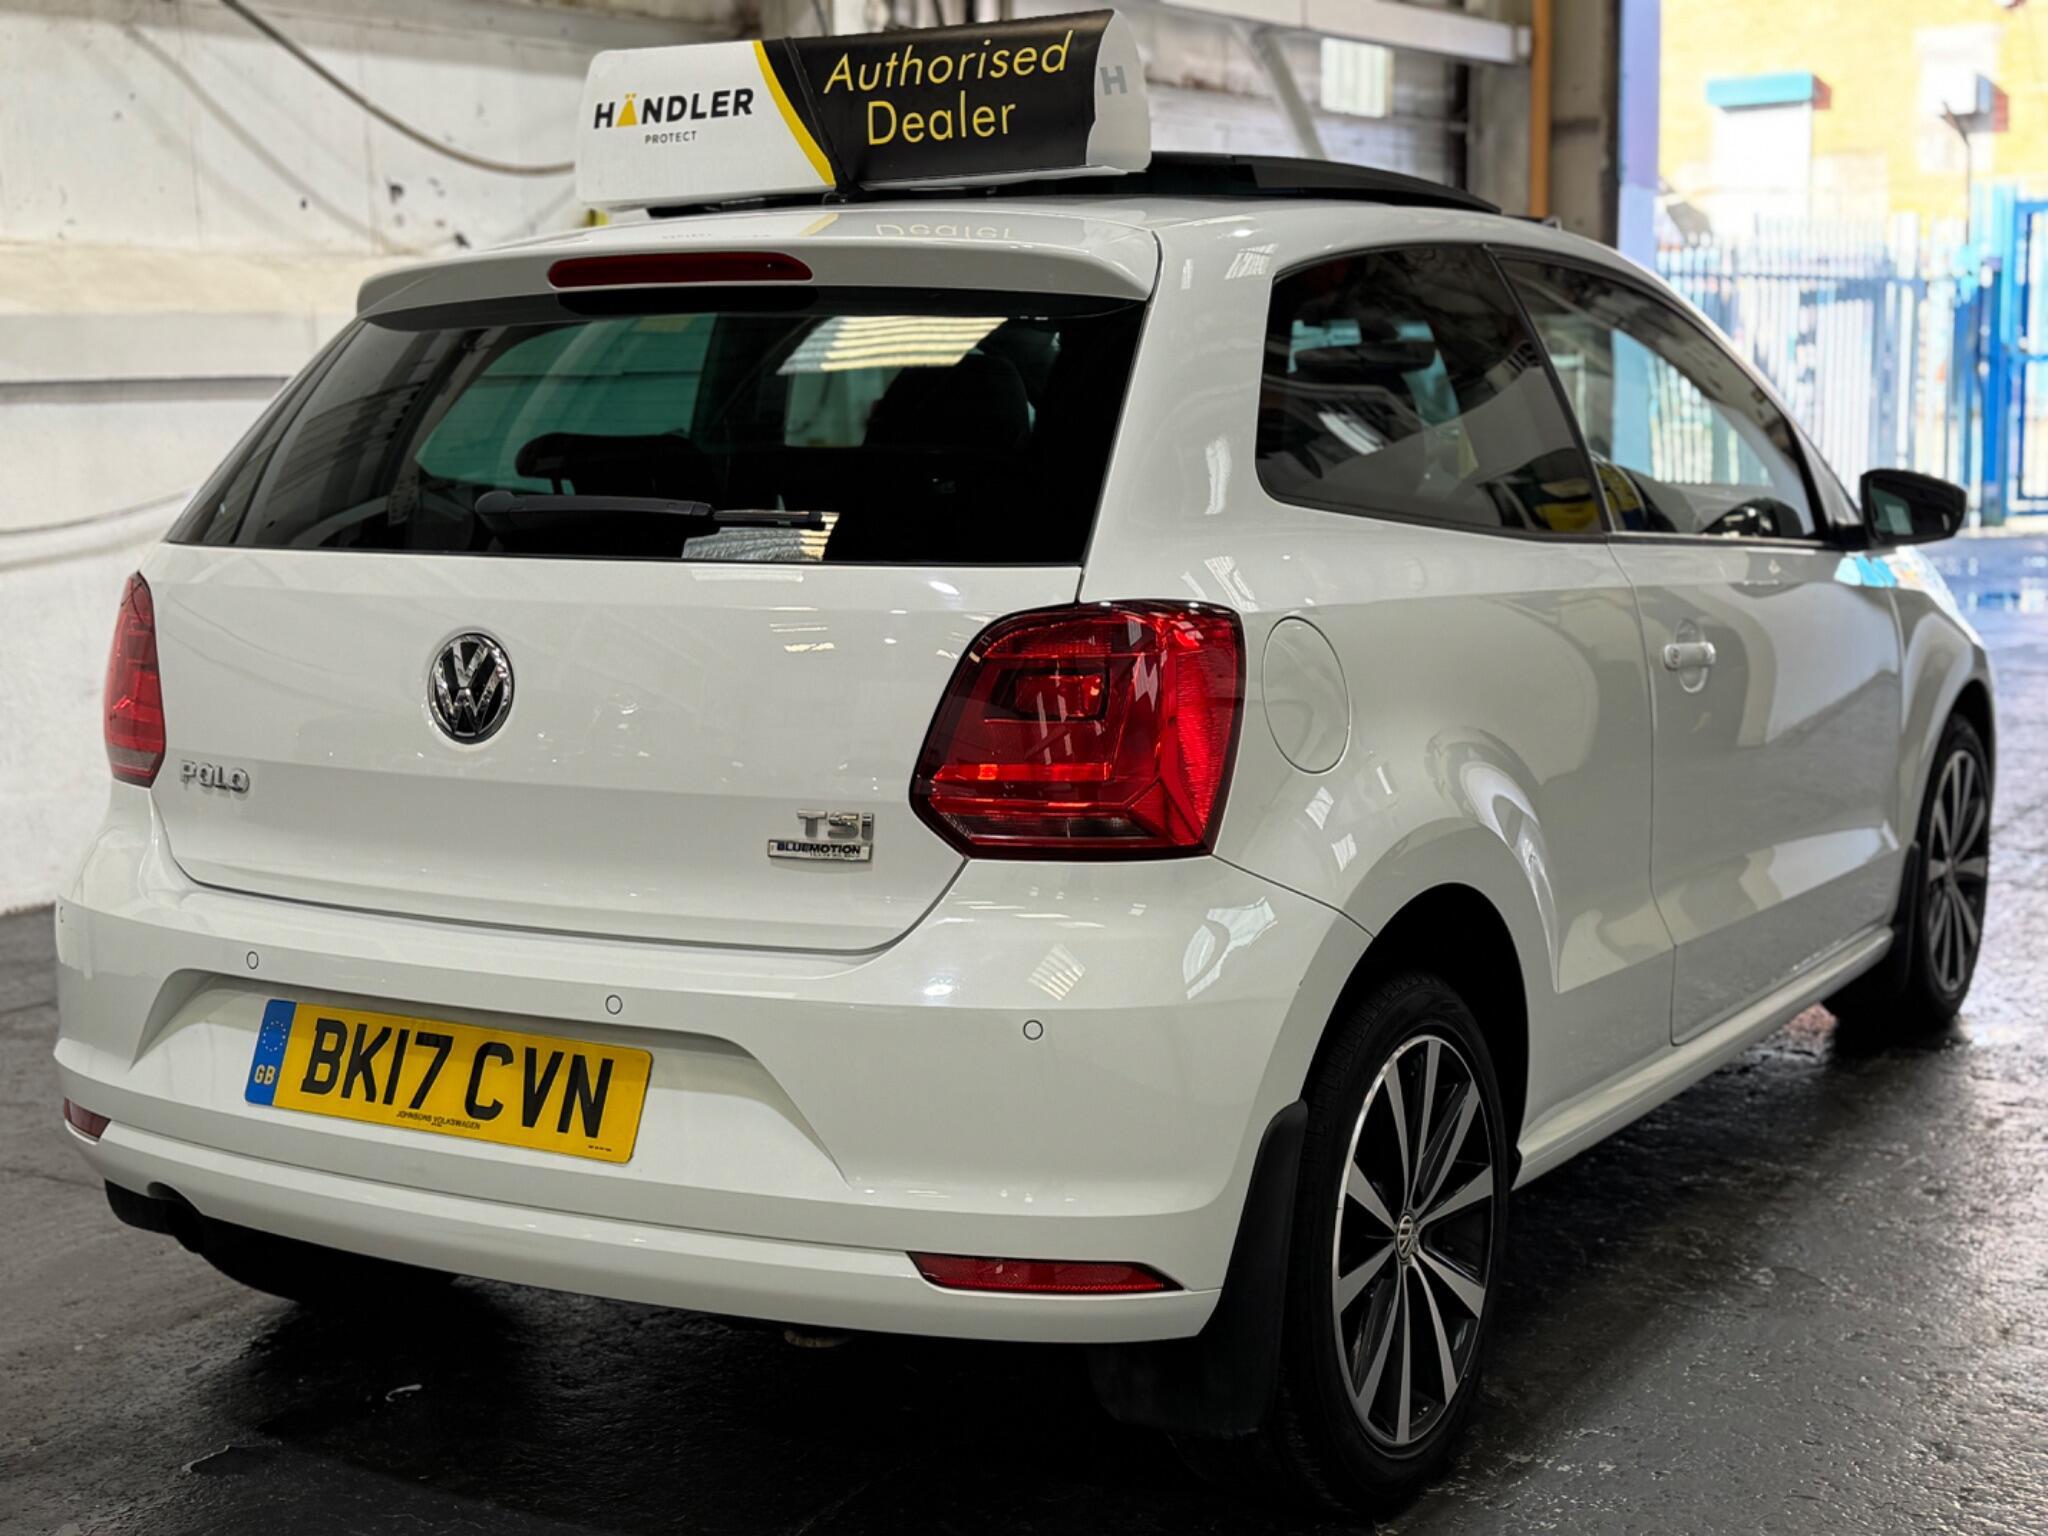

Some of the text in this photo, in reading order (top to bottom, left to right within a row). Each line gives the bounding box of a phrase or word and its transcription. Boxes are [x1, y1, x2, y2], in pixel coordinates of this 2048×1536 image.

[823, 29, 1073, 95] Authorised
[1099, 66, 1128, 95] H
[594, 88, 754, 129] HÄNDLER
[866, 91, 1017, 146] Dealer
[645, 130, 697, 144] PROTECT
[180, 760, 250, 794] POLO
[777, 841, 861, 854] BLUEMOTION
[254, 1065, 275, 1085] GB
[300, 1017, 614, 1139] BK17 CVN
